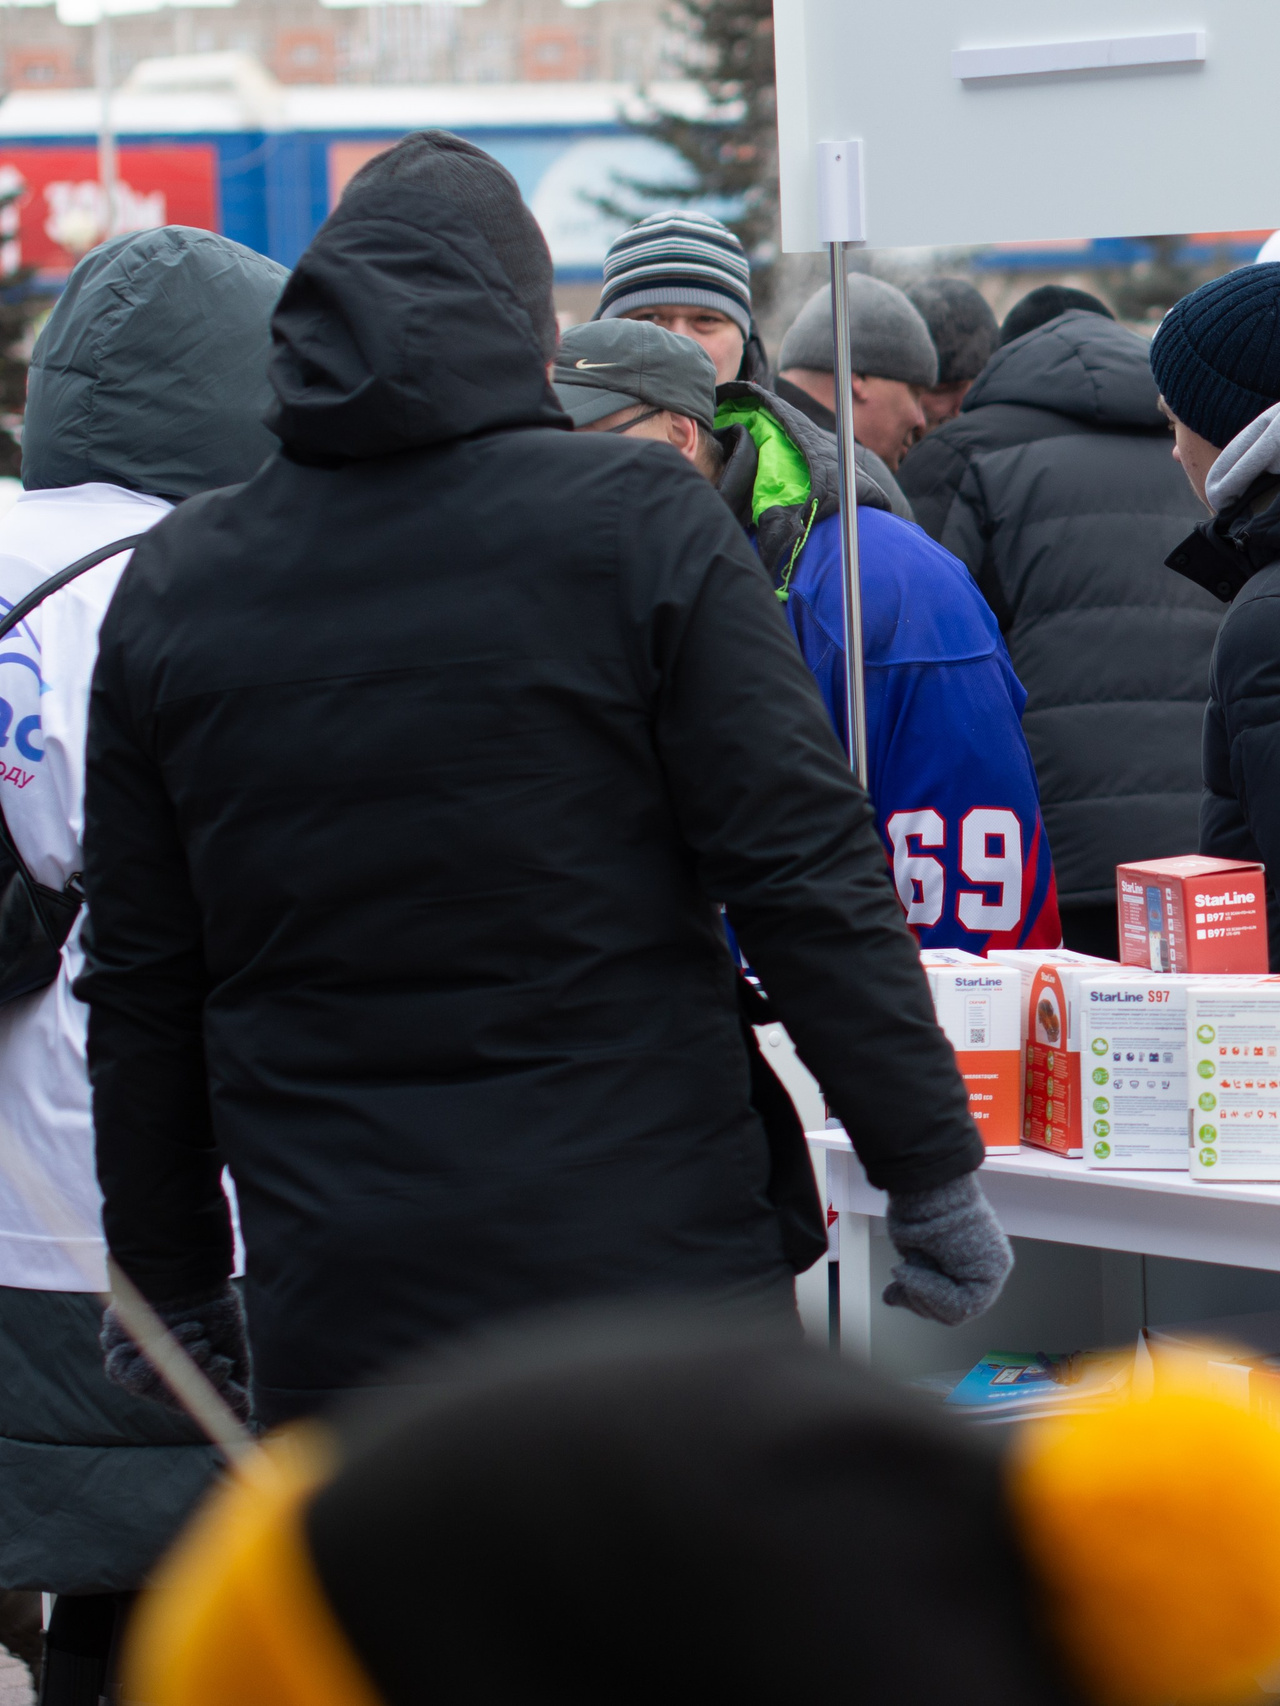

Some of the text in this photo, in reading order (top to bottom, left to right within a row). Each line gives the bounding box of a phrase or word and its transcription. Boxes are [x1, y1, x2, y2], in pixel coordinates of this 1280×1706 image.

[887, 806, 1023, 932] 69
[1122, 881, 1143, 894] StarLine
[1195, 892, 1255, 907] StarLine
[1206, 912, 1225, 923] B97
[1207, 928, 1226, 939] B97
[955, 977, 1002, 987] StarLine
[1090, 990, 1171, 1003] StarLine S97
